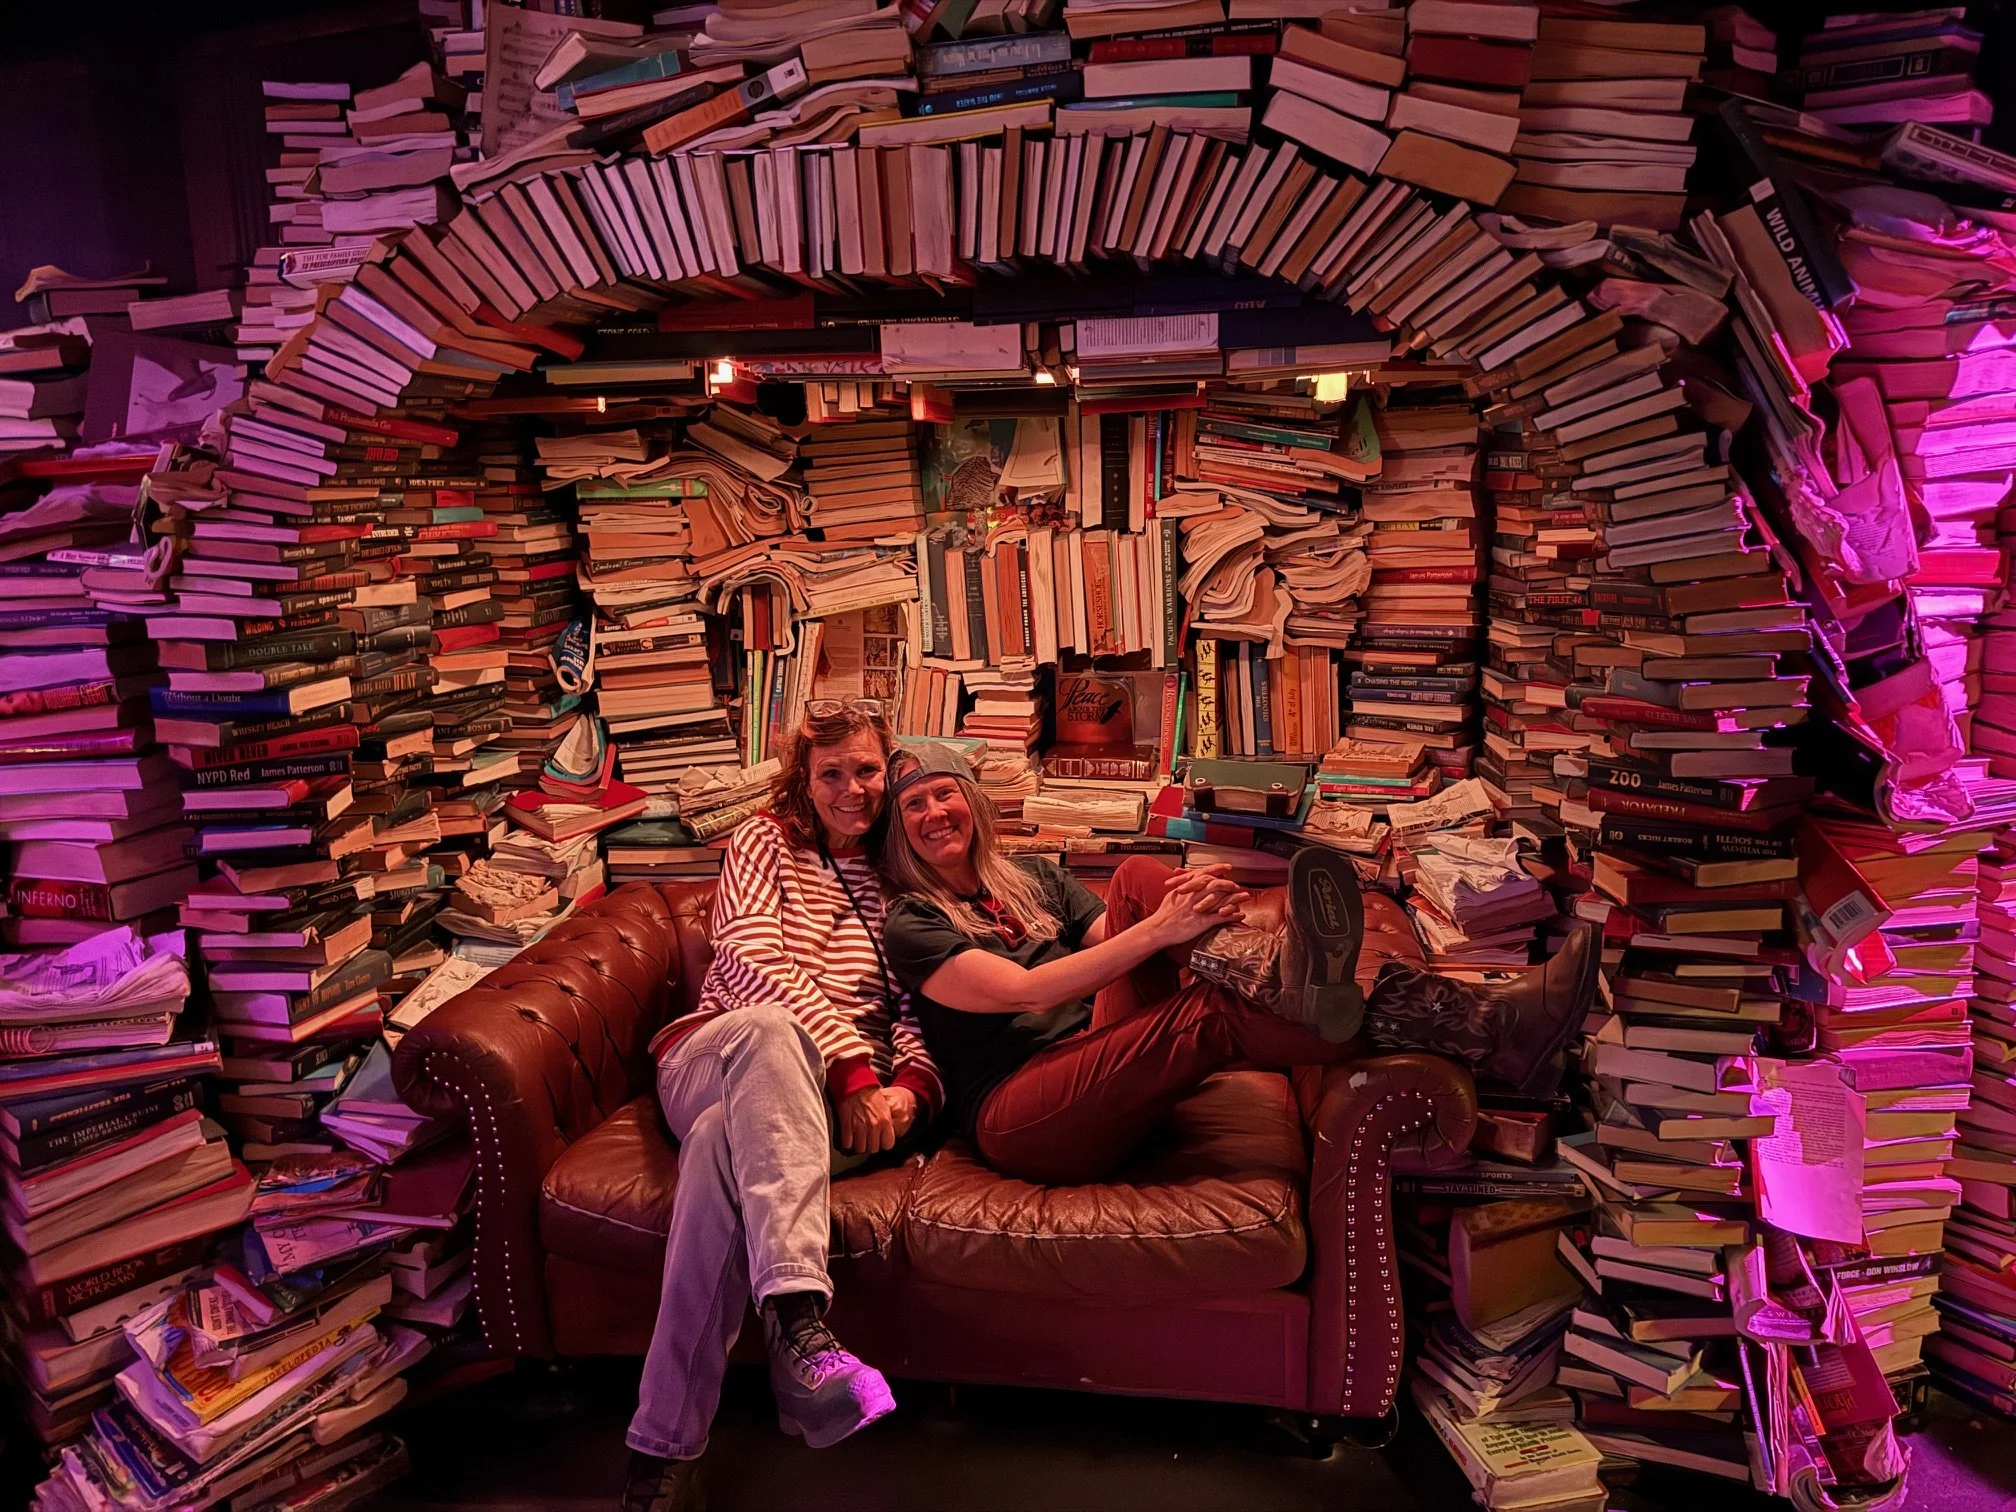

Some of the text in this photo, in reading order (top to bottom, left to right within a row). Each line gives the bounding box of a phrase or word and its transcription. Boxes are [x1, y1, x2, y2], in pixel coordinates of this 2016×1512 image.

[1765, 207, 1796, 253] WILD
[379, 419, 391, 430] Go
[1408, 570, 1453, 580] James Patterson
[1165, 574, 1173, 614] WARRIORS
[1528, 595, 1545, 604] THE
[1546, 595, 1570, 604] FIRST
[244, 620, 274, 635] WILDING
[1167, 617, 1175, 646] PACIFIC
[248, 643, 314, 657] DOUBLE TAKE
[393, 671, 416, 690] HEAT
[1389, 678, 1400, 686] THE
[161, 691, 201, 703] Without
[211, 693, 241, 703] Doubt
[1288, 688, 1297, 701] July
[467, 722, 492, 733] BONES
[197, 763, 325, 785] NYPD Red James Patterson
[1609, 769, 1713, 797] ZOO James Patterson
[1621, 799, 1686, 817] PREDATOR
[1638, 833, 1694, 845] ROBERT HICKS
[1716, 834, 1752, 846] SOUTH
[1721, 844, 1777, 856] THE WIDOW
[16, 889, 76, 909] INFERNO
[47, 1104, 160, 1149] THE IMPERIAL CRUISE
[1480, 1171, 1512, 1180] SPORTS
[1441, 1184, 1496, 1194] STAY TUNED
[64, 1257, 146, 1297] WORLD BOOK
[1836, 1261, 1919, 1281] FORCE DON WINSLOW
[67, 1272, 137, 1306] DICTIONARY
[262, 1336, 333, 1385] JOKELOPEDIA
[1486, 1443, 1518, 1457] Everyday
